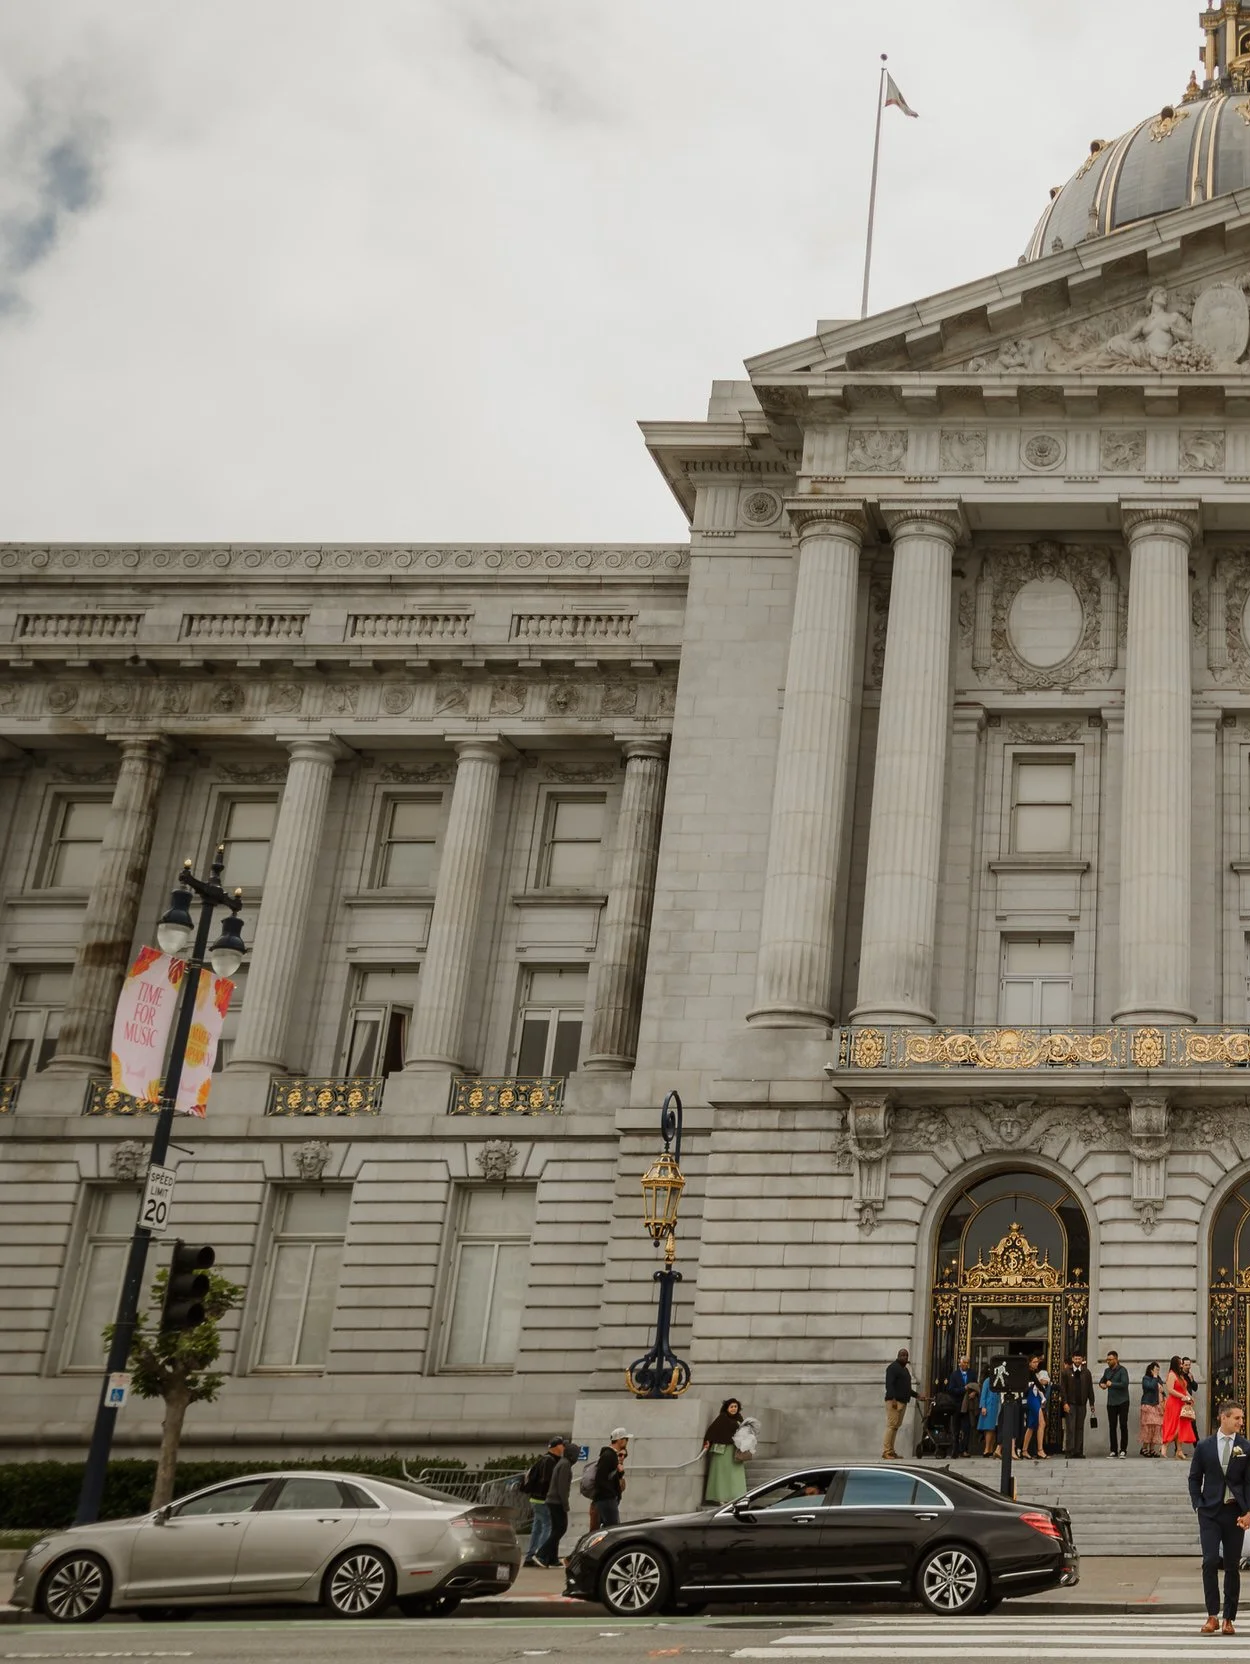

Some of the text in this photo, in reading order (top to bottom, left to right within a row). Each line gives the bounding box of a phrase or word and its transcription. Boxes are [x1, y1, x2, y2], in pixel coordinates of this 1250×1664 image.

[139, 981, 165, 1007] TIME
[133, 1003, 156, 1026] FOR
[124, 1022, 158, 1048] MUSIC
[151, 1172, 173, 1187] SPEED
[151, 1186, 168, 1198] LIMIT
[144, 1198, 166, 1223] 20
